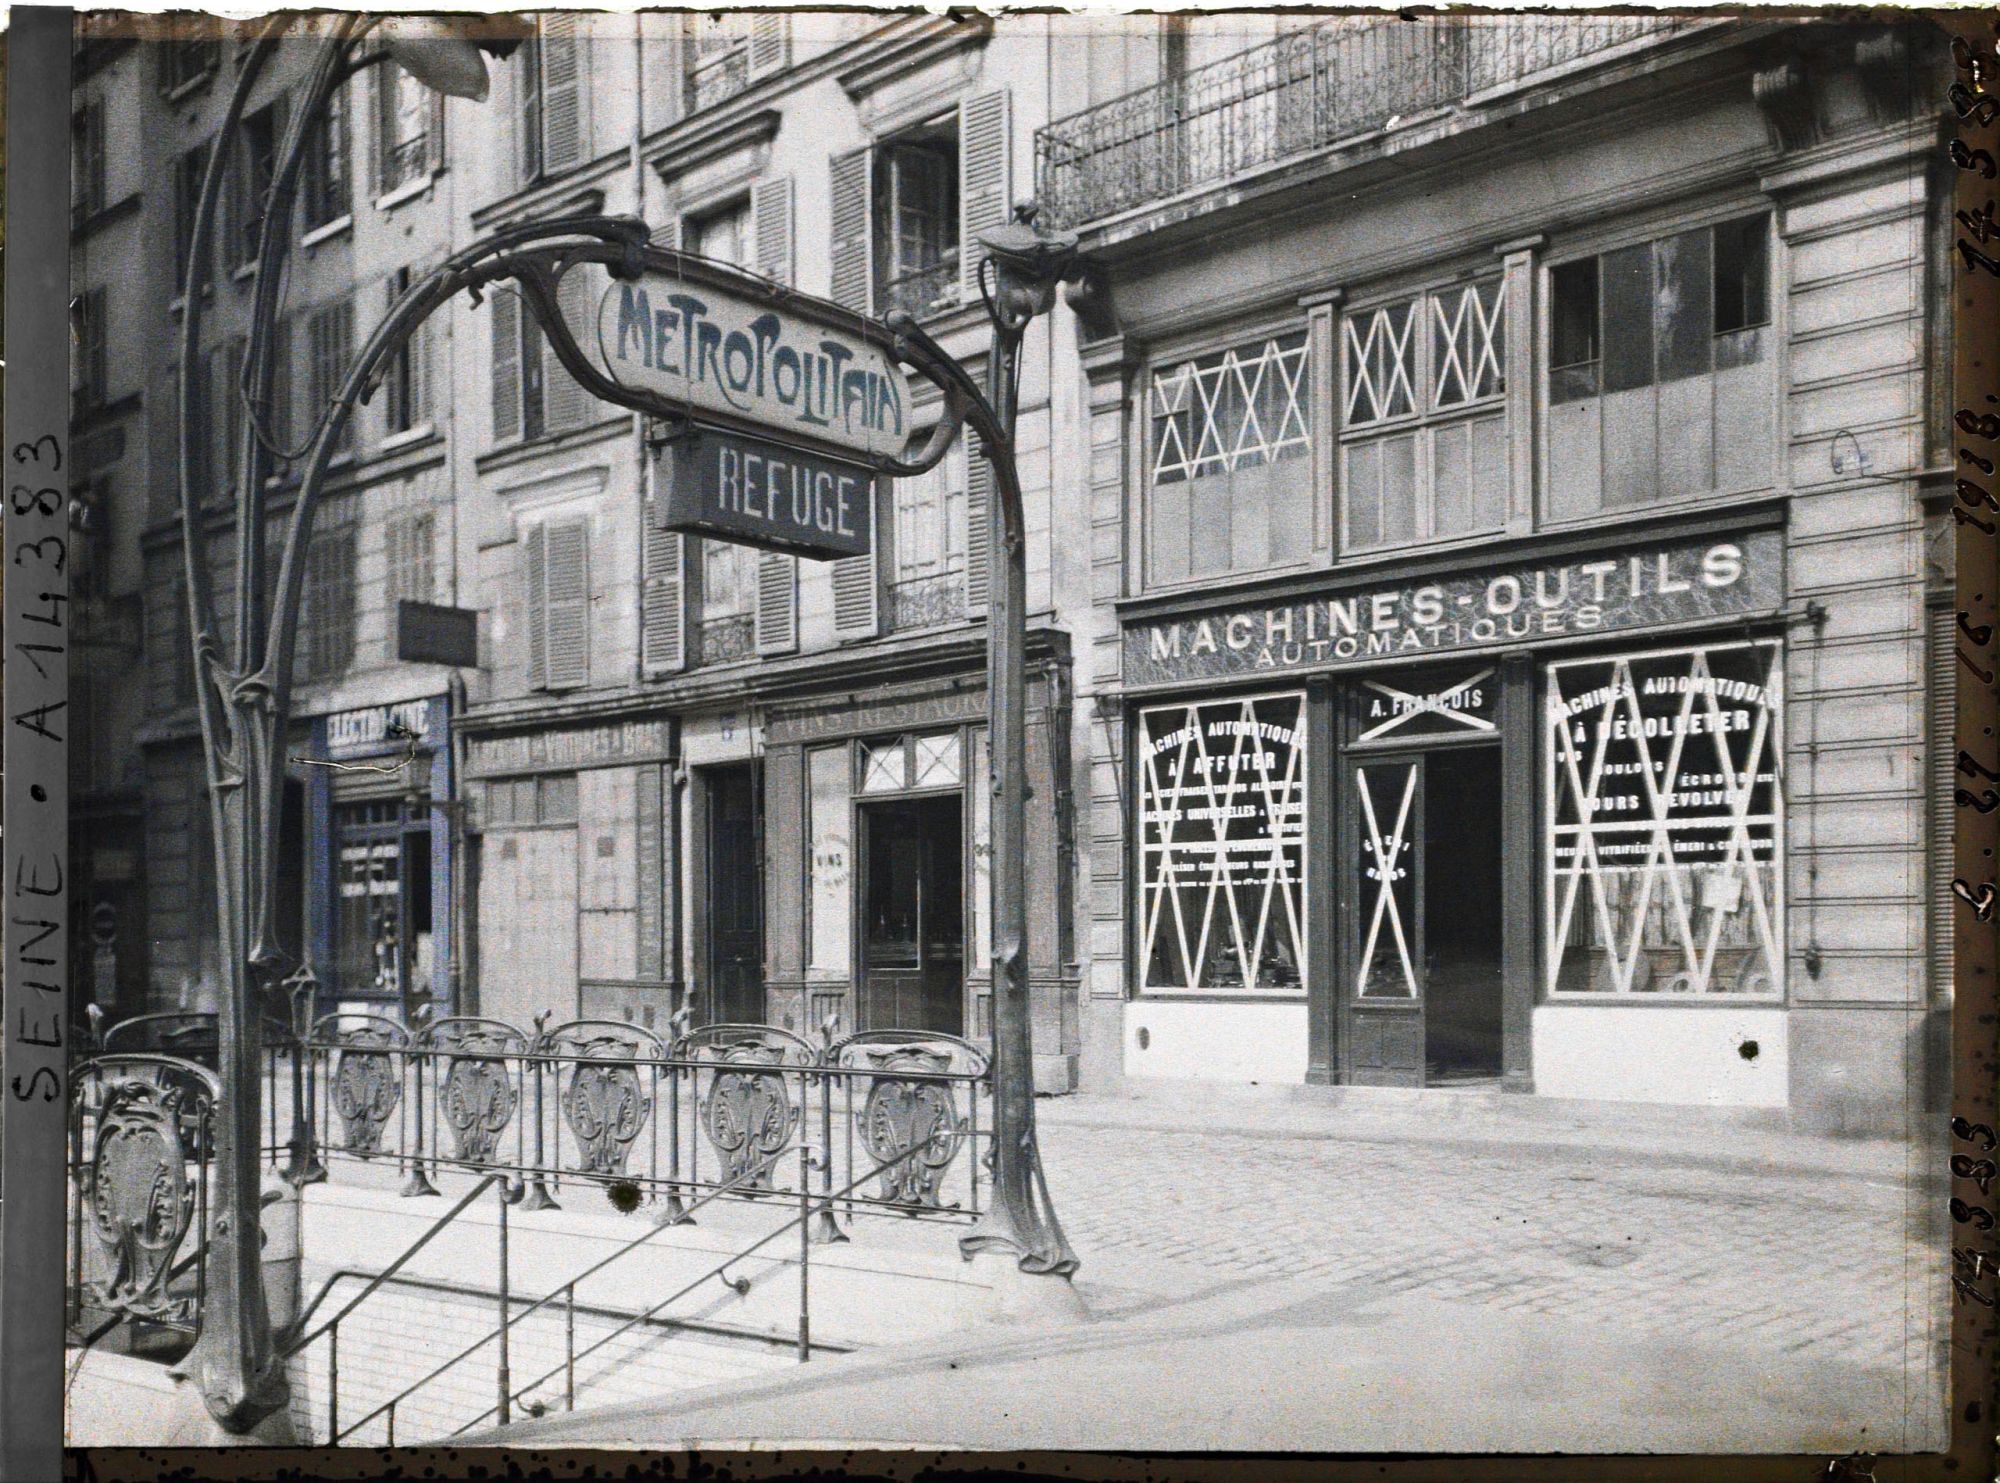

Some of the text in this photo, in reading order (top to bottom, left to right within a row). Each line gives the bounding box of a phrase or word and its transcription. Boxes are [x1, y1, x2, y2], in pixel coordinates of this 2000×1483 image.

[617, 285, 902, 436] METROPOLITAIN
[719, 448, 856, 537] REFUGE
[1254, 606, 1601, 667] AUTOMATIQUES
[1371, 700, 1387, 717] A.
[1597, 710, 1751, 740] DÉCOLLETER
[1141, 725, 1202, 758] ACHINES
[1557, 750, 1583, 762] VS
[1593, 761, 1665, 776] OULOS
[12, 853, 63, 1103] SEINE
